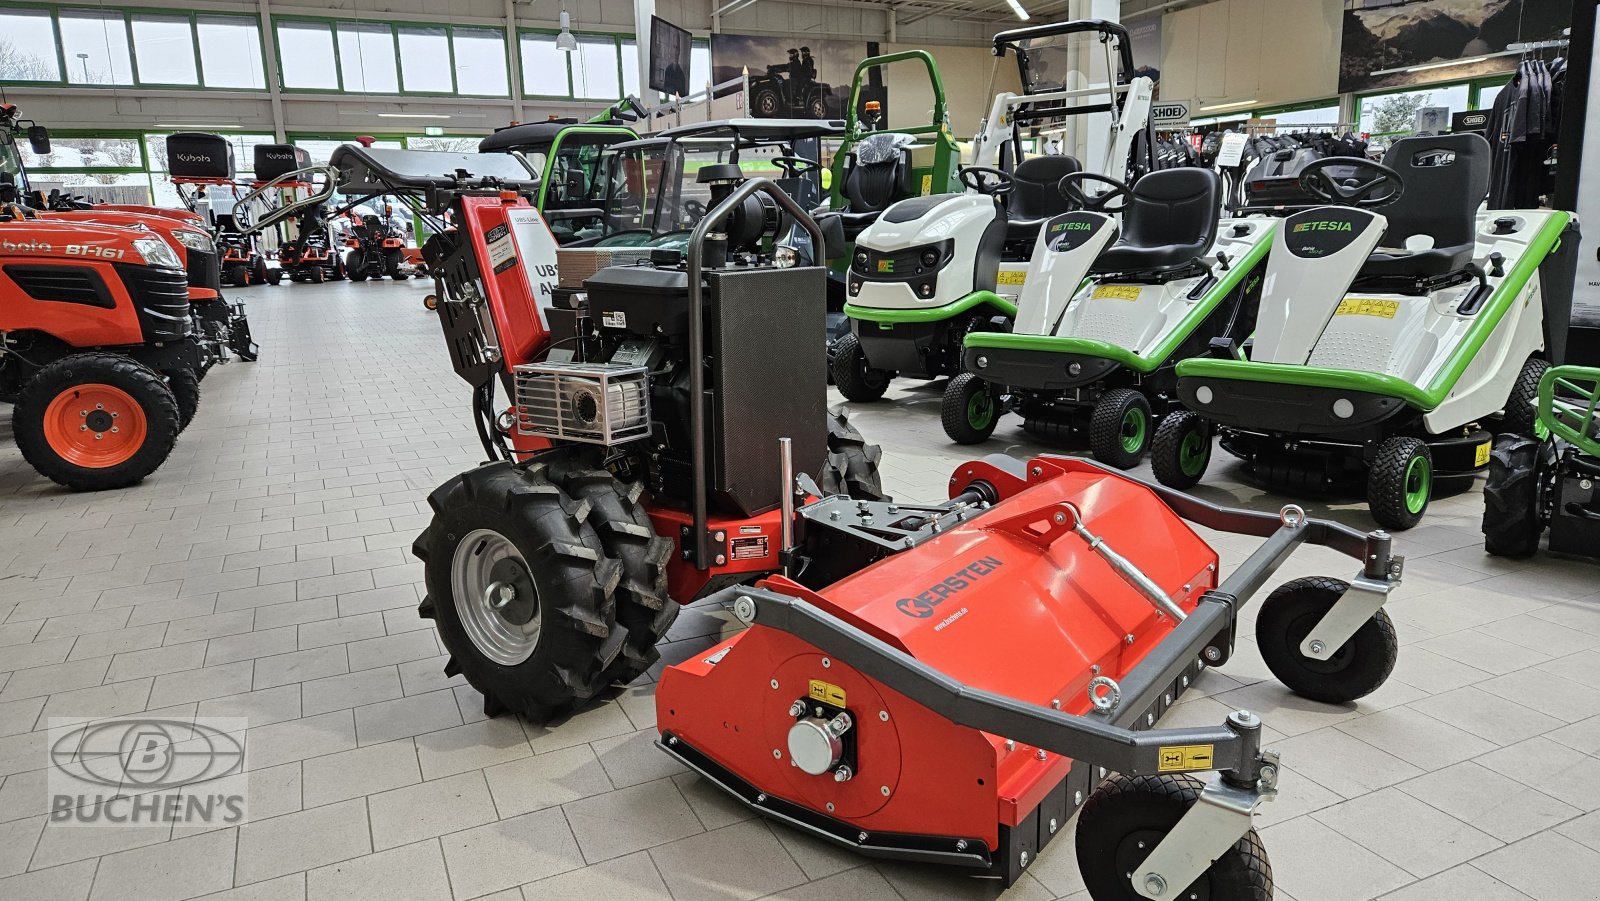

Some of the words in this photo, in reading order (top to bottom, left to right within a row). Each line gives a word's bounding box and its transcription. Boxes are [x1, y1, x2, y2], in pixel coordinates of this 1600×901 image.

[1153, 107, 1181, 118] SHOEI
[1466, 116, 1484, 124] SHOEI
[177, 153, 211, 163] Kubota
[266, 152, 293, 160] Kubota
[1057, 222, 1091, 231] ETESIA
[1302, 221, 1352, 232] ETESIA
[2, 239, 52, 253] bota
[65, 244, 125, 259] B1-161
[896, 556, 1004, 618] KERSTEN
